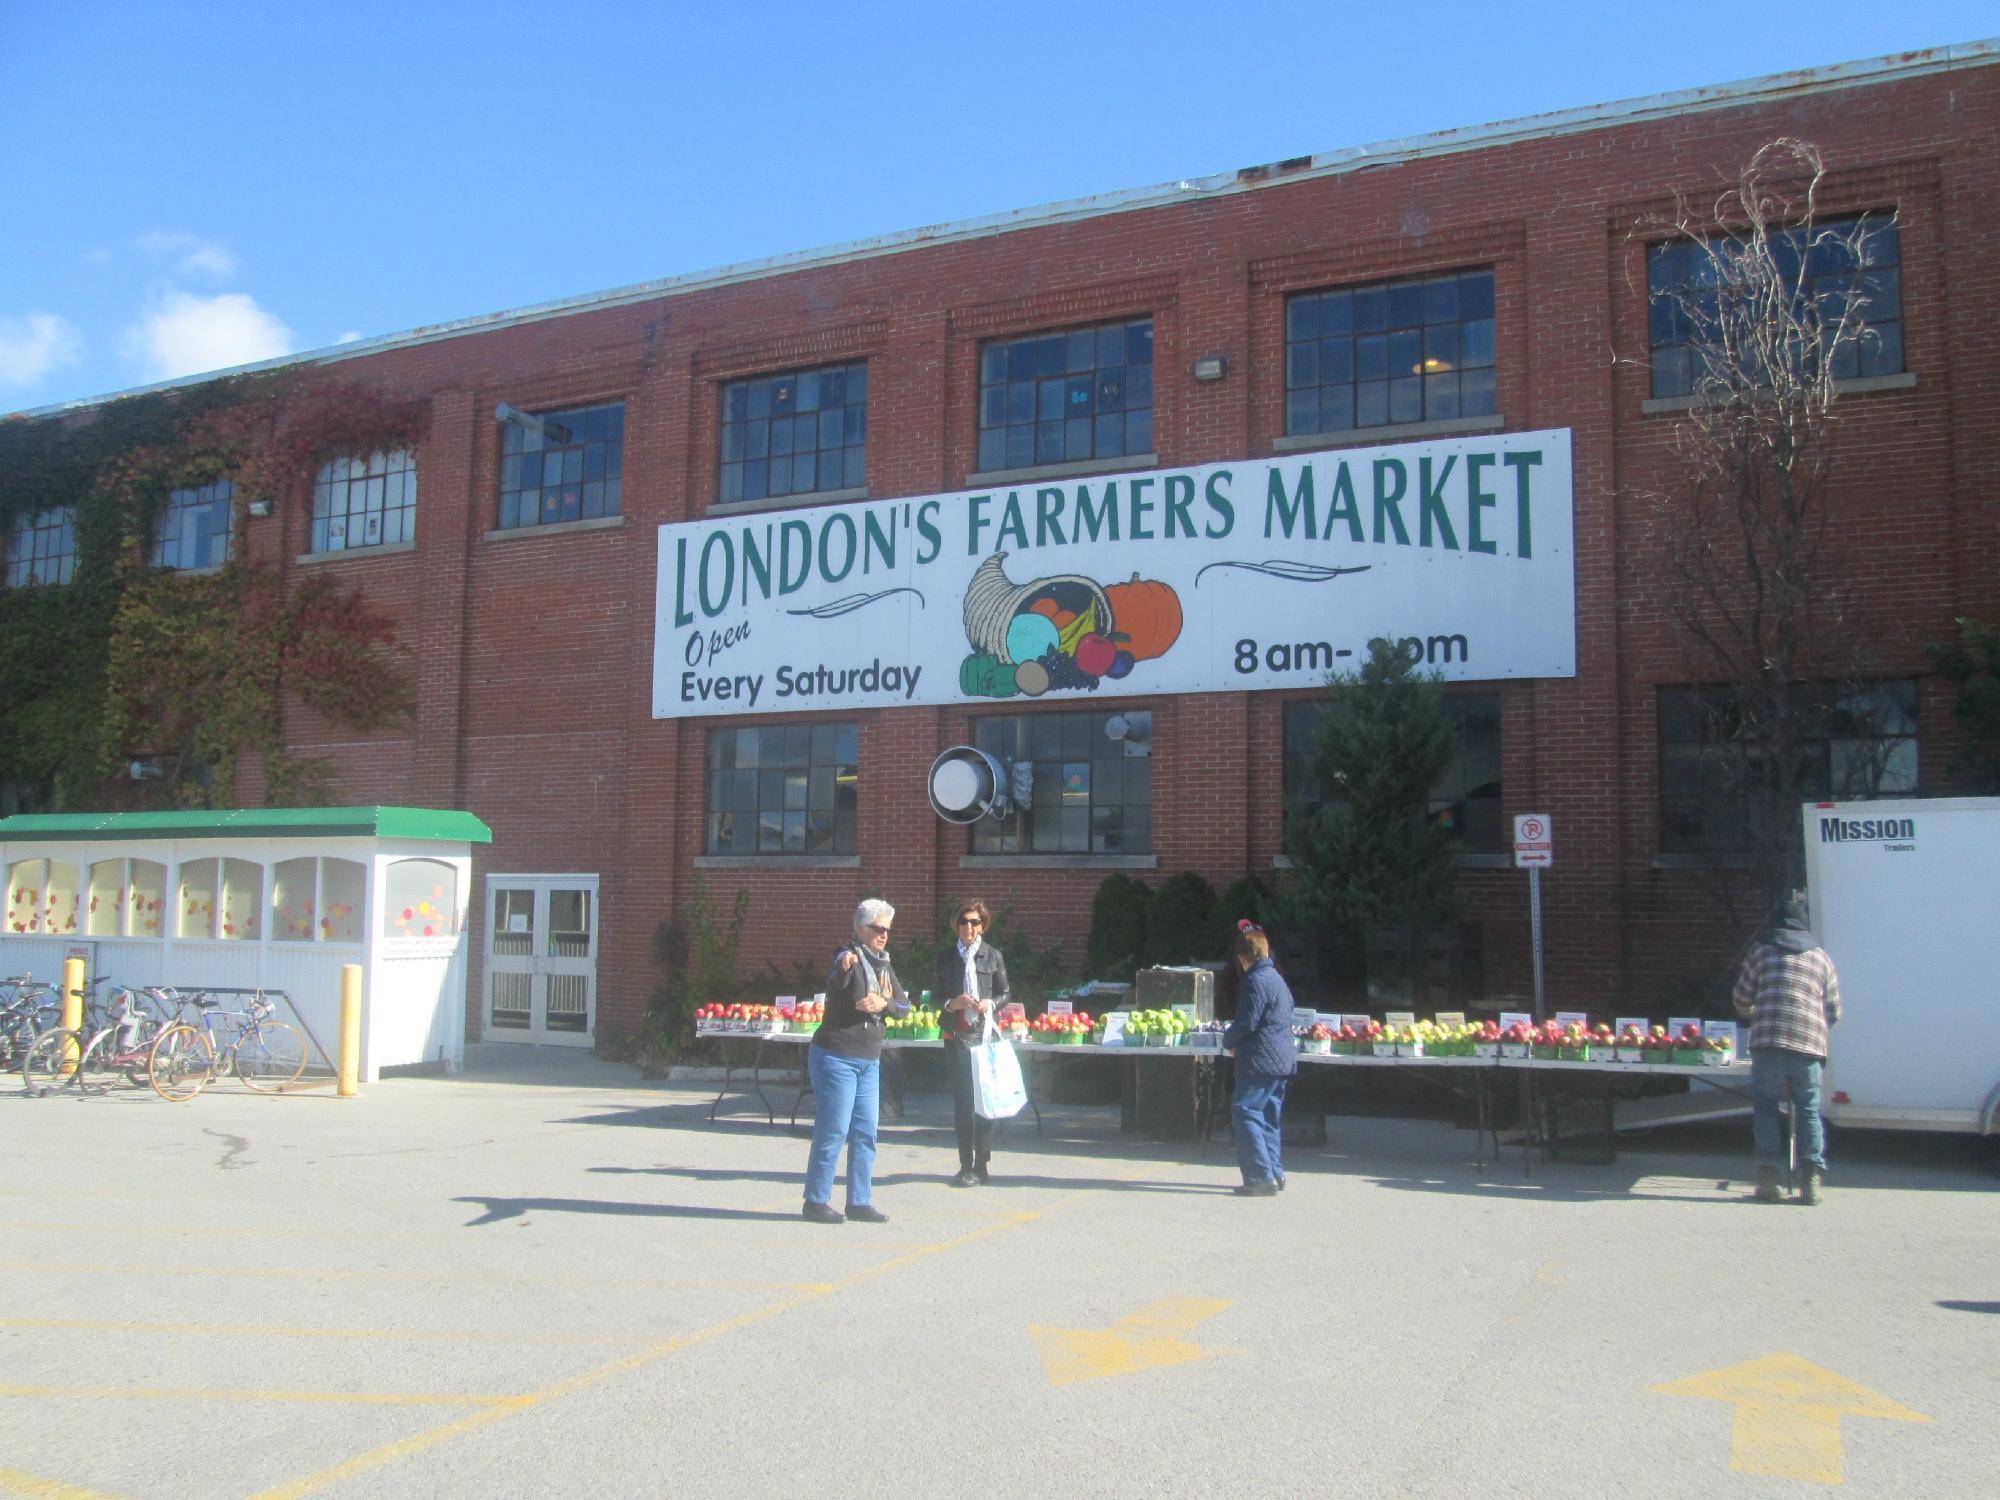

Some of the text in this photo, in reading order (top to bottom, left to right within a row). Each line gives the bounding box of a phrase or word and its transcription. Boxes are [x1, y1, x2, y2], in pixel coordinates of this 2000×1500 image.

[674, 450, 1543, 629] LONDON'S FARMERS MARKET
[684, 618, 752, 668] Open
[680, 658, 922, 707] Every Saturday
